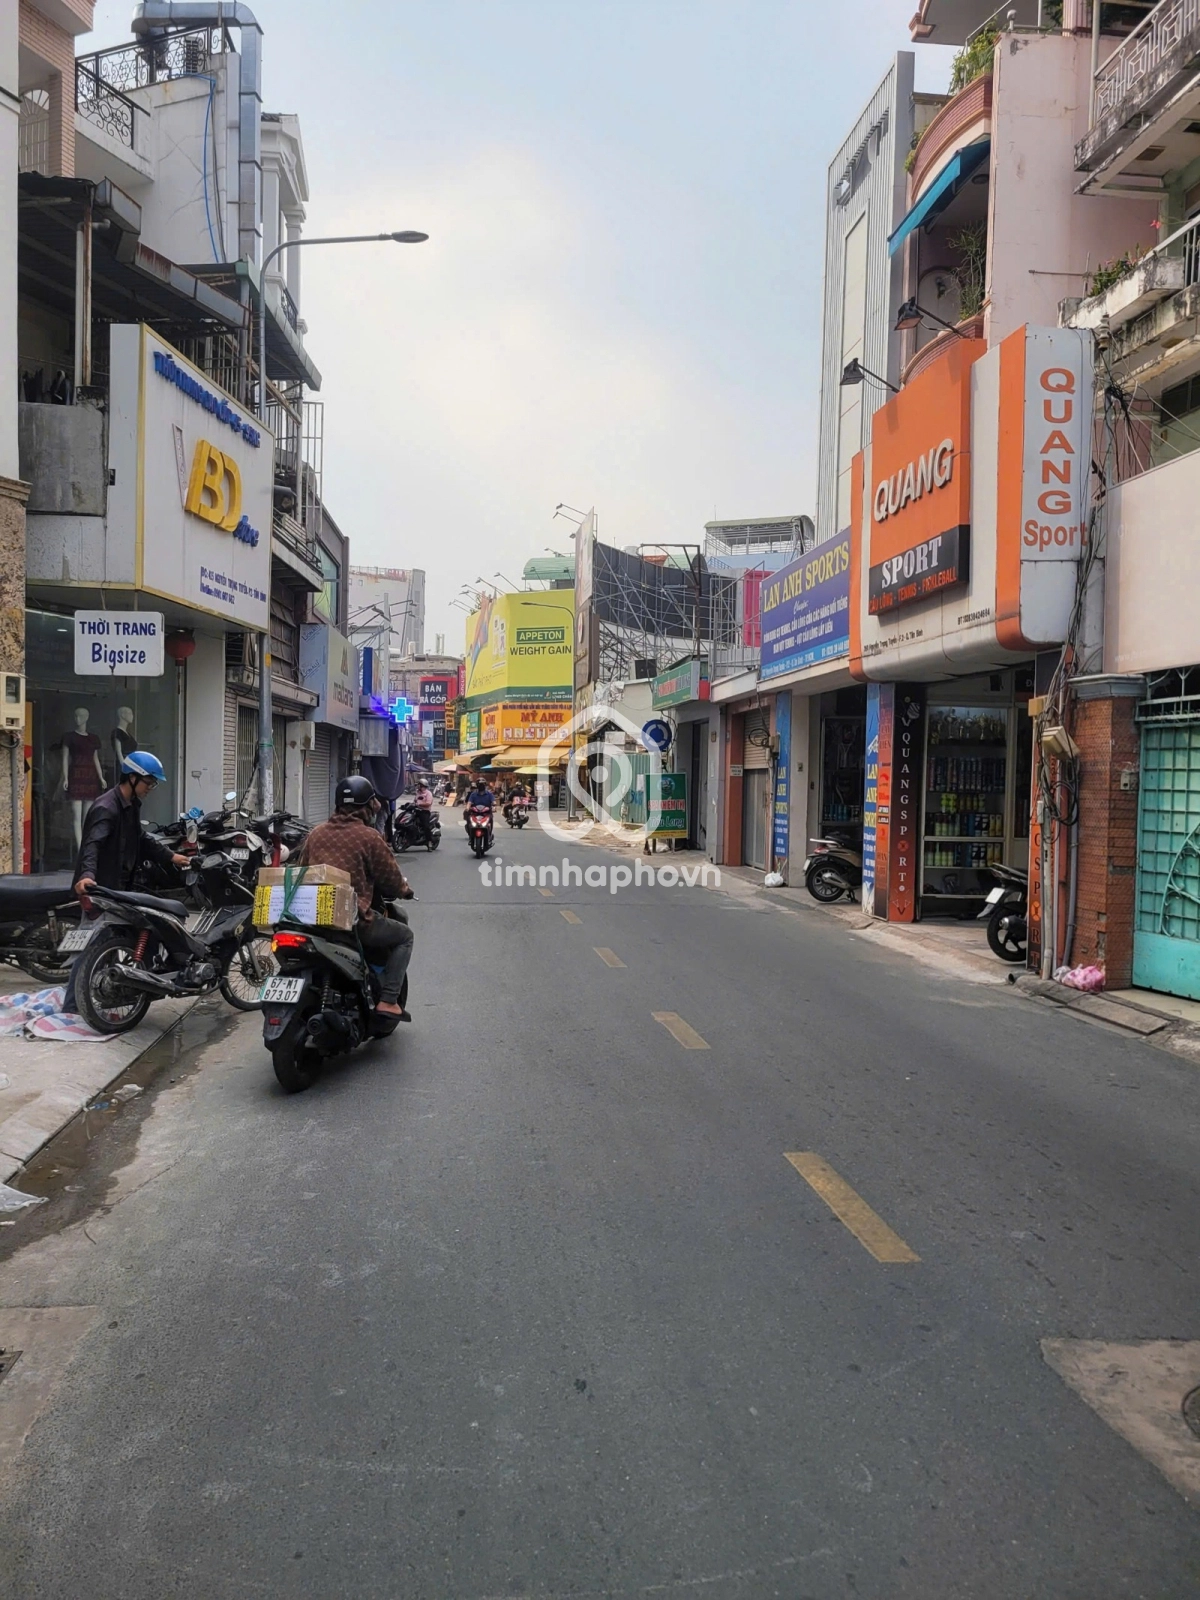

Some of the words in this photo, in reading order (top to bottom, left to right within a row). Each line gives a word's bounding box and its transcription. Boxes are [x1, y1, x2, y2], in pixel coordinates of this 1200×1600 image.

[1037, 367, 1076, 515] QUANG
[873, 438, 954, 522] QUANG
[1023, 519, 1088, 552] Sport
[881, 535, 942, 589] SPORT
[763, 581, 781, 613] LAN
[781, 568, 804, 603] ANH
[805, 541, 849, 591] SPORTS
[79, 618, 110, 635] THỜI
[114, 622, 156, 636] TRANG
[519, 631, 562, 641] APPETON
[509, 646, 546, 655] WEIGHT
[548, 645, 572, 655] GAIN
[92, 642, 146, 674] Bigsize
[425, 683, 442, 693] BÁN
[430, 694, 446, 704] GÓP
[520, 710, 538, 723] MỸ
[540, 712, 564, 723] ANH
[666, 816, 684, 828] Long
[334, 950, 361, 965] AIRBLAD
[264, 989, 298, 1001] 873.07
